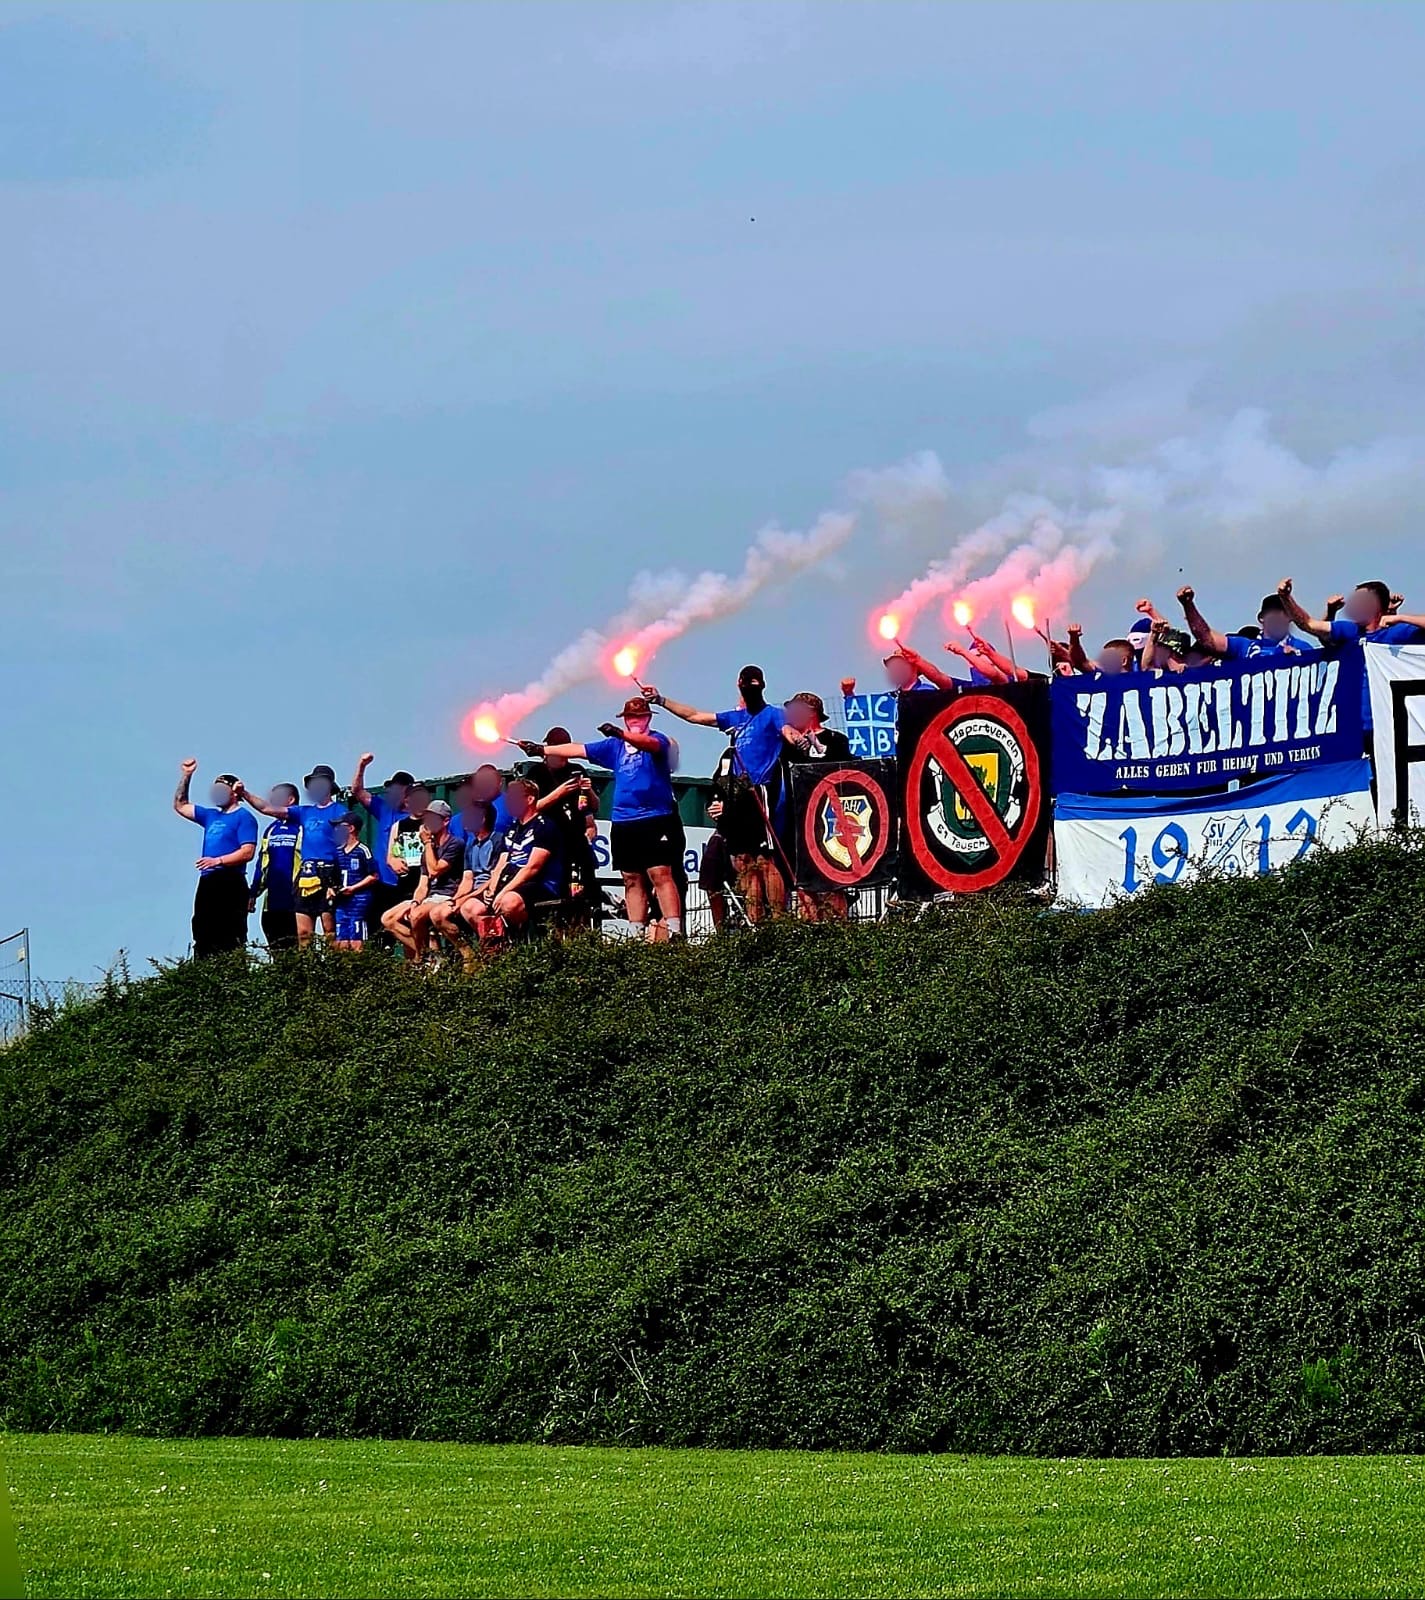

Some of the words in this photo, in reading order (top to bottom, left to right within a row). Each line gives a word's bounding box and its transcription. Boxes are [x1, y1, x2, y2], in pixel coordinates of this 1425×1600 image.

[1077, 660, 1340, 761] ZABELTITZ
[952, 724, 1019, 758] dsportverein
[1116, 766, 1149, 779] ALLES
[1155, 762, 1190, 777] GEBEN
[1222, 755, 1259, 773] HEIMAT
[1264, 752, 1284, 766] UND
[1209, 823, 1226, 838] SV
